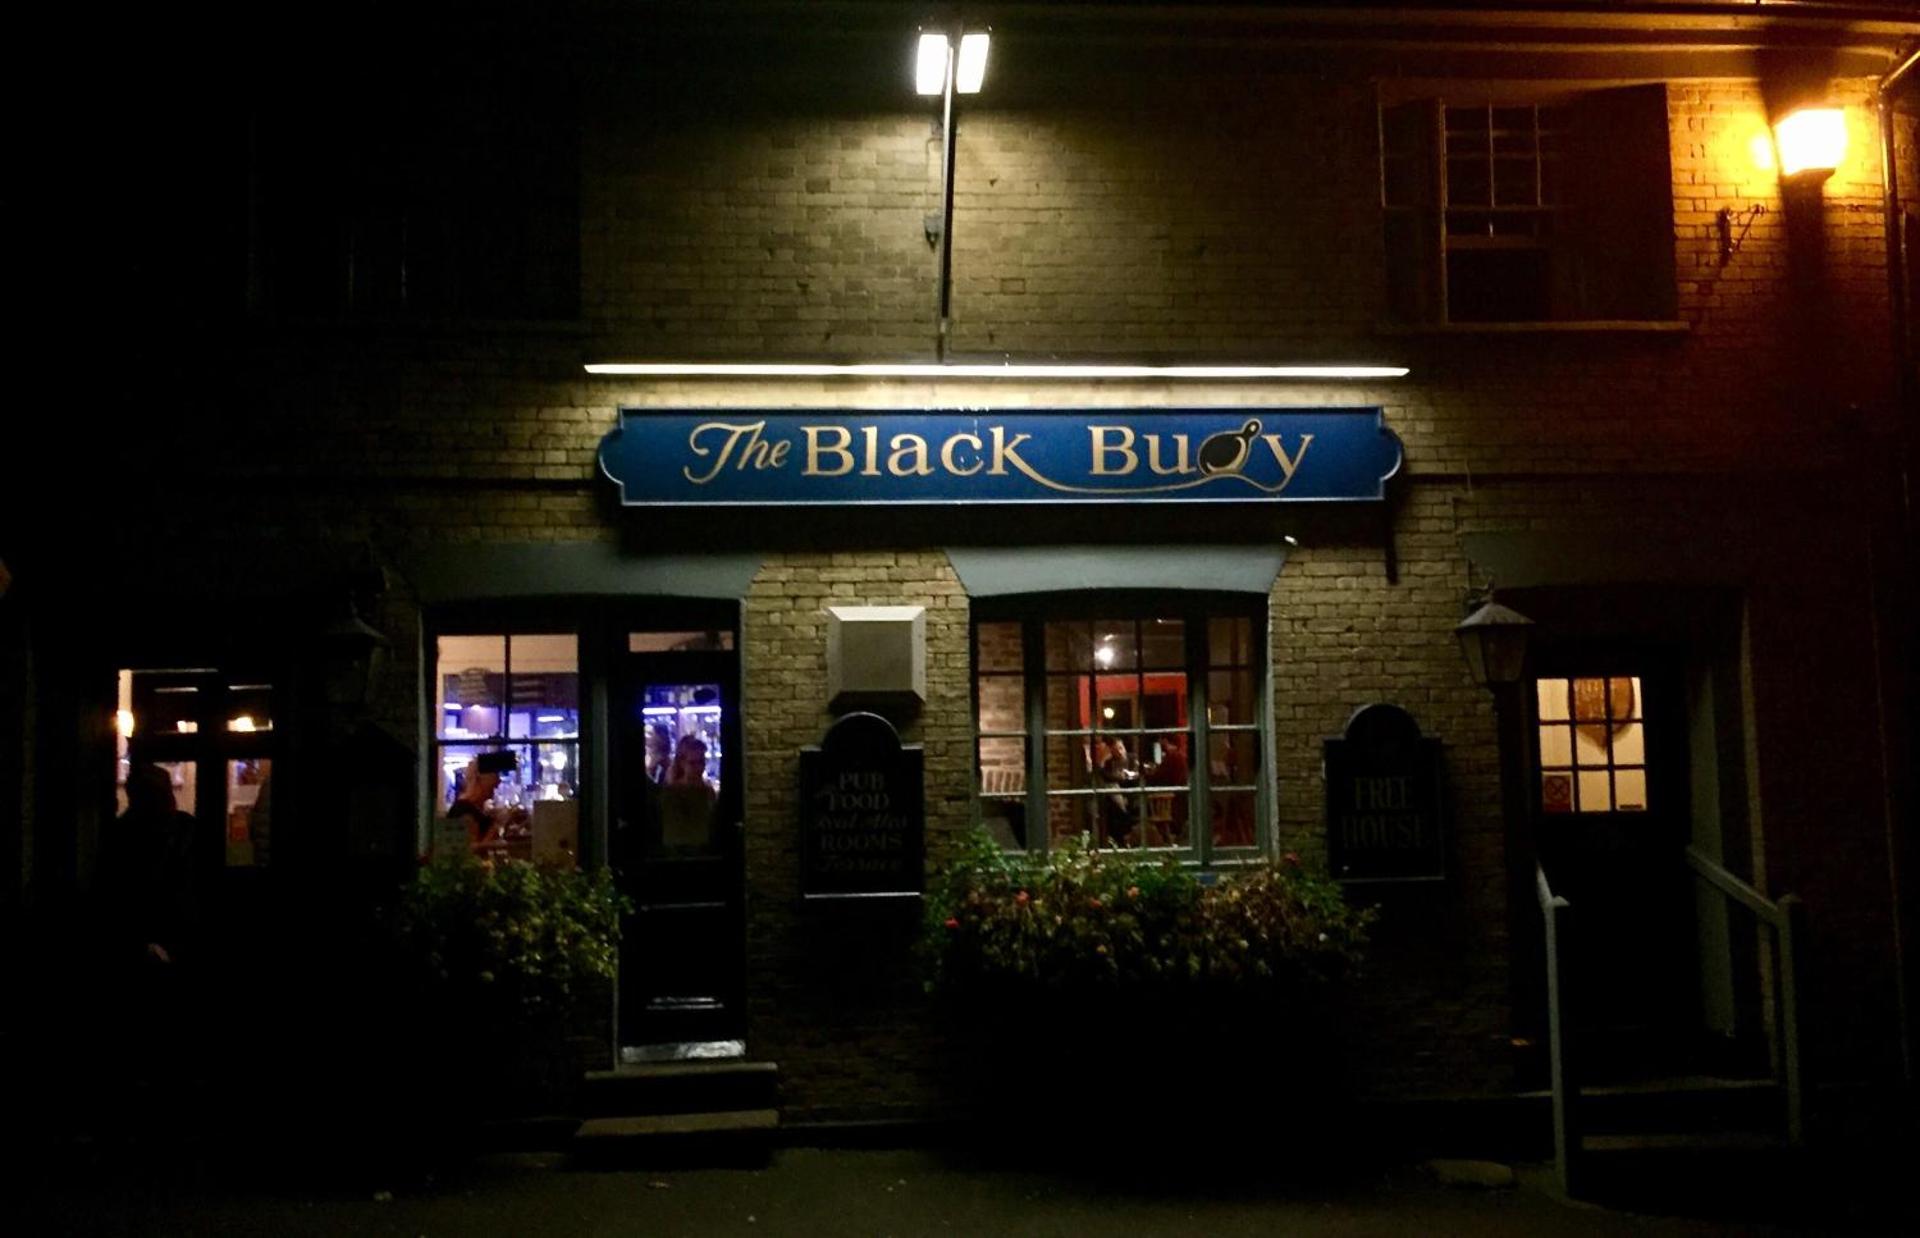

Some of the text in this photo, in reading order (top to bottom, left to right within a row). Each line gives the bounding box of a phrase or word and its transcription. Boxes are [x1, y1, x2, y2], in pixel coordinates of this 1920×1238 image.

[683, 418, 1315, 493] The Black Buoy
[838, 771, 885, 791] PUB
[1353, 775, 1415, 810] FREE
[813, 783, 891, 812] FOOD
[820, 830, 903, 851] ROOMS
[1341, 812, 1432, 850] HOUSE
